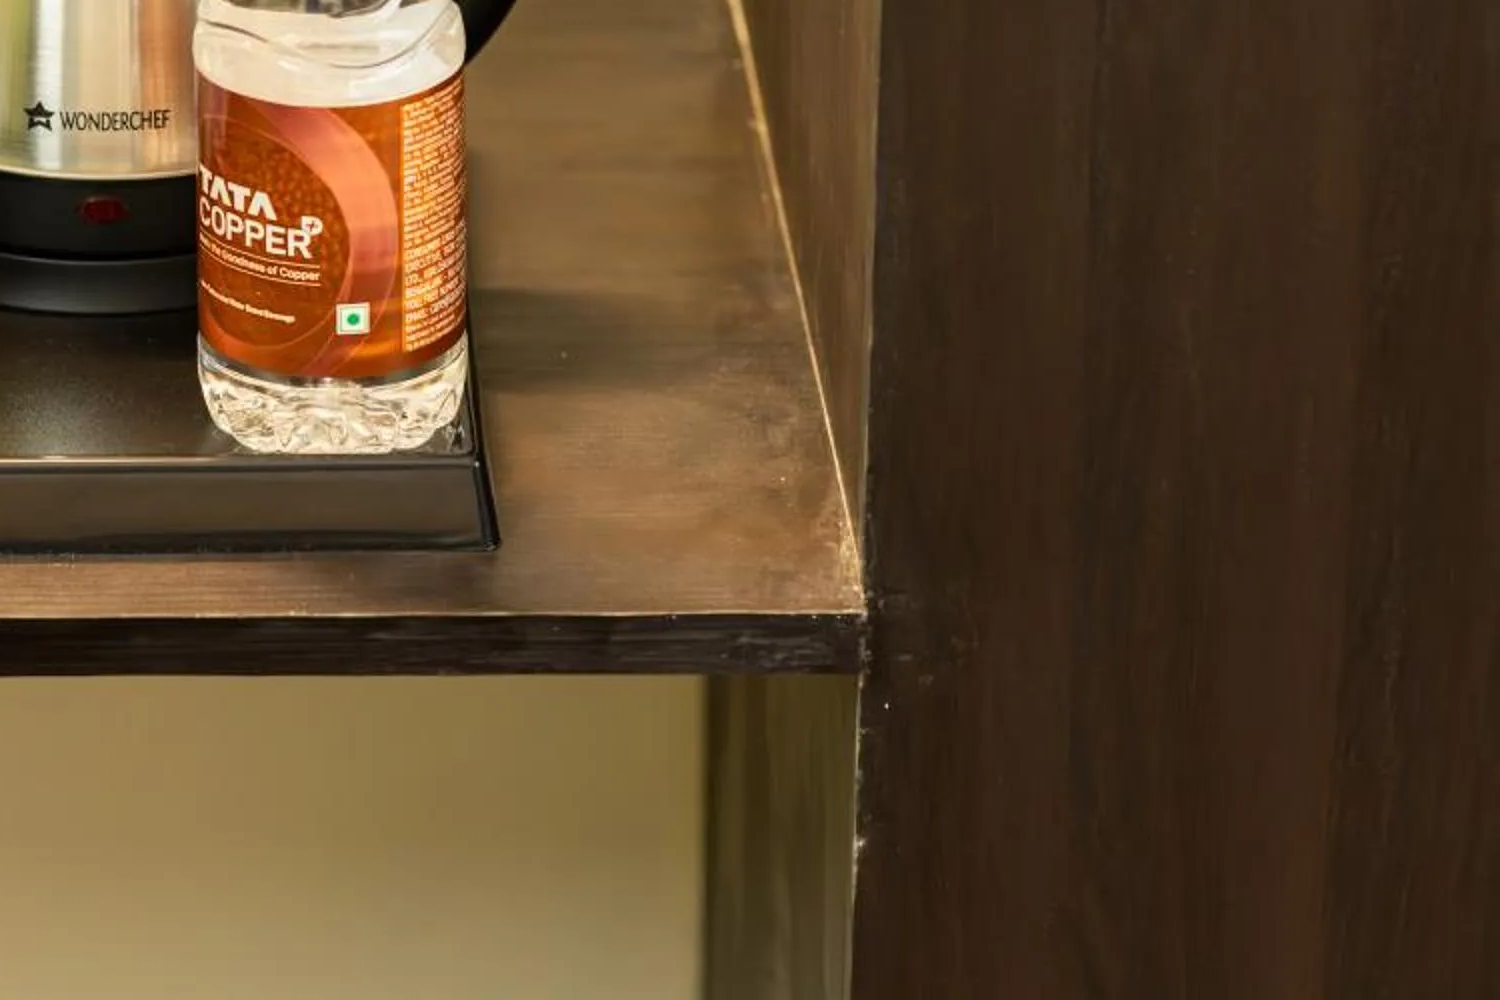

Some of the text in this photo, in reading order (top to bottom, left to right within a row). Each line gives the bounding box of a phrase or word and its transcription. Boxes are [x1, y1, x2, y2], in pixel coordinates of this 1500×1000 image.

[60, 109, 171, 131] WONDERCHEF
[200, 163, 277, 221] TATA
[200, 196, 313, 259] COPPER
[279, 266, 321, 281] Copper
